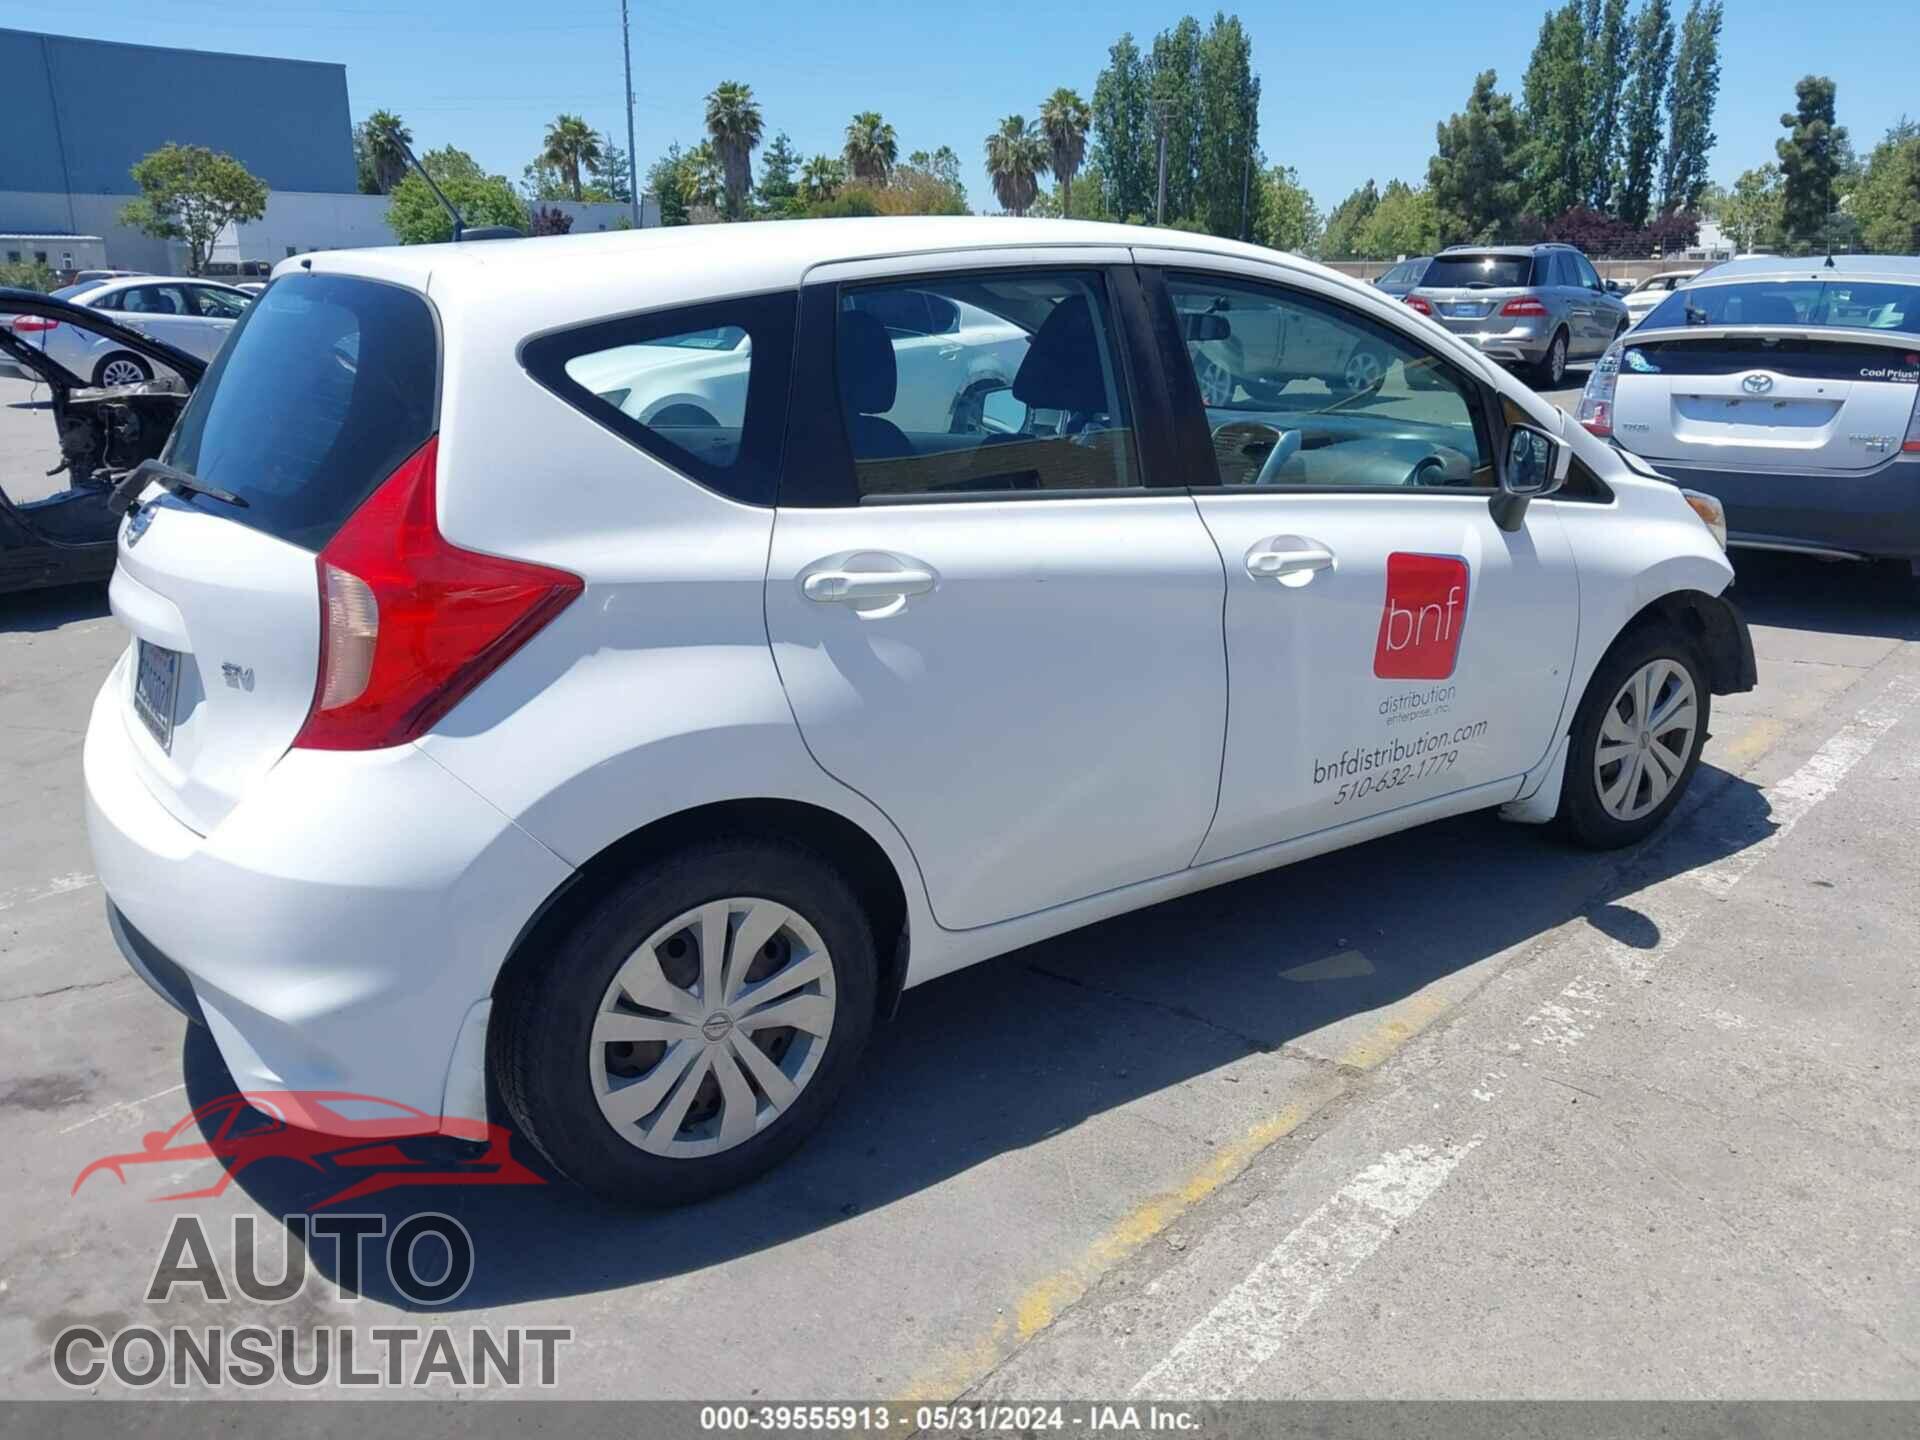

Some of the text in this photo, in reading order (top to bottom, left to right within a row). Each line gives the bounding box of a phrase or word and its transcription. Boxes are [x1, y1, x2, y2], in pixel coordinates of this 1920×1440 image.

[1860, 368, 1886, 377] Cool
[1386, 586, 1461, 651] bnf
[1378, 684, 1456, 714] distribution
[1313, 720, 1488, 785] bnfdistribution.com
[1334, 750, 1459, 806] 510-632-1779
